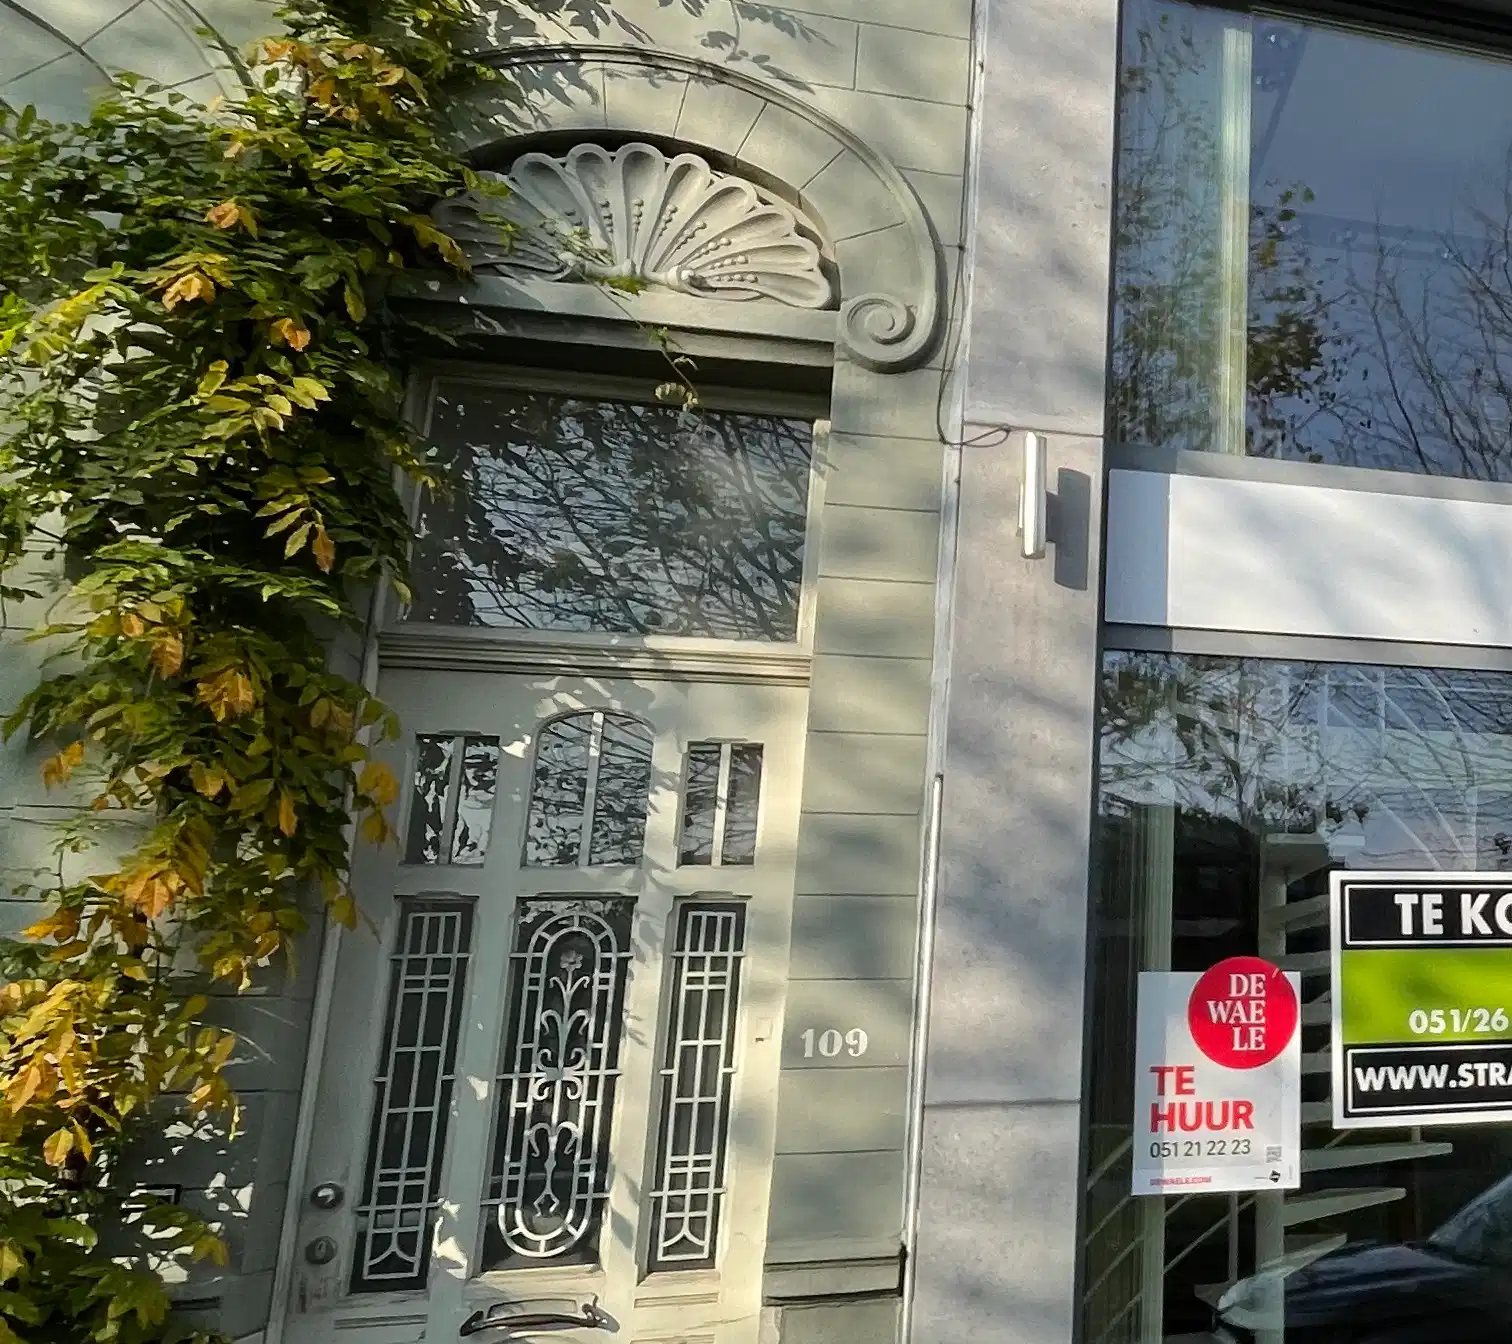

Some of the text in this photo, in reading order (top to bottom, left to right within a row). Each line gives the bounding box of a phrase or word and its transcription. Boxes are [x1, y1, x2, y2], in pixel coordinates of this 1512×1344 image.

[1394, 892, 1445, 936] TE
[1229, 973, 1267, 998] DE
[1206, 1000, 1267, 1025] WAE
[1408, 1007, 1509, 1035] 051/26
[801, 1027, 868, 1058] 109
[1231, 1027, 1267, 1052] LE
[1149, 1065, 1196, 1097] TE
[1150, 1100, 1255, 1134] HUUR
[1150, 1138, 1251, 1158] 051 21 22 23
